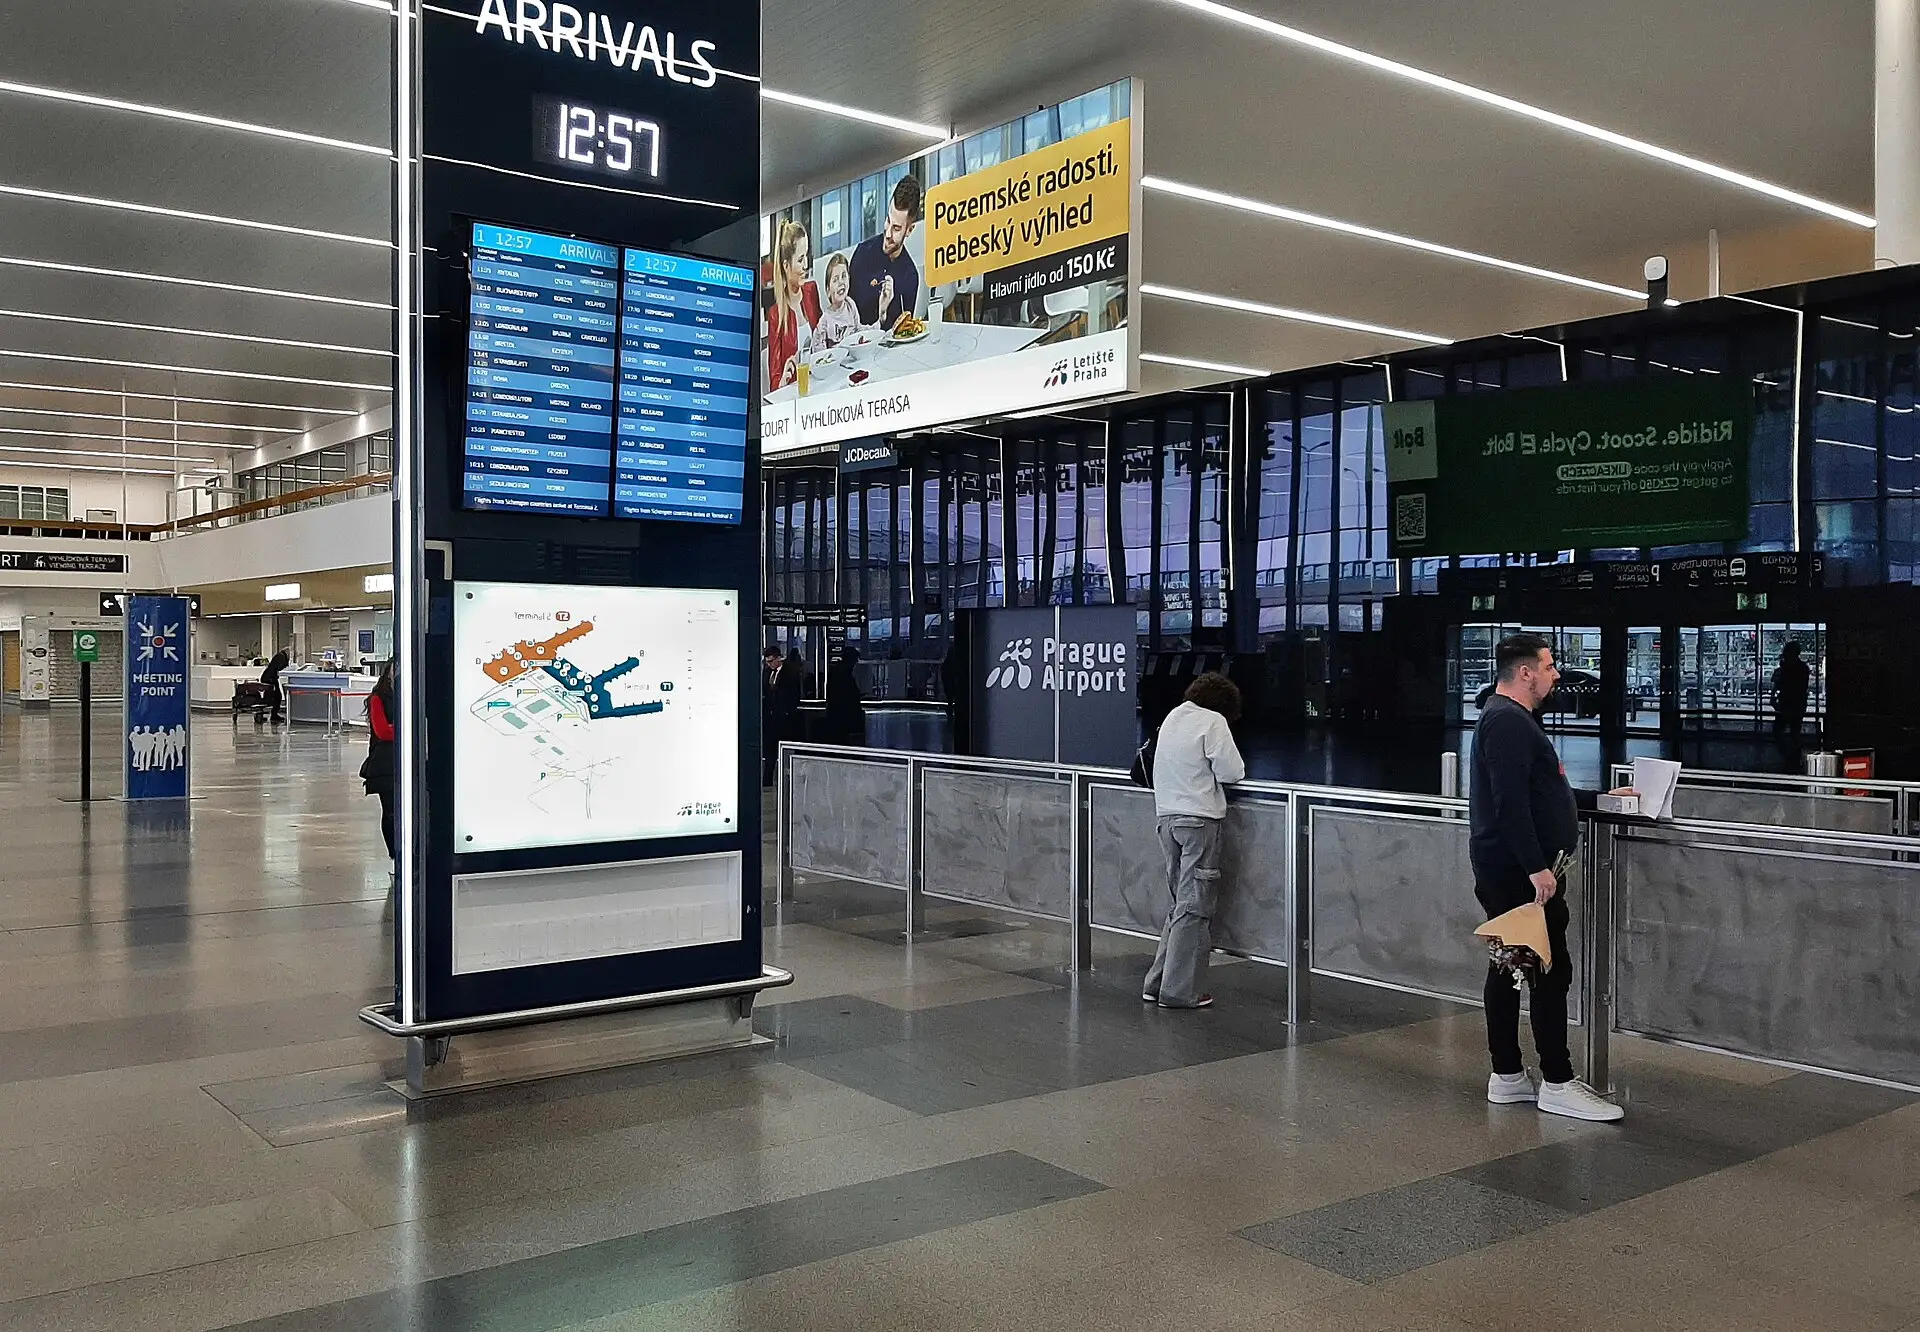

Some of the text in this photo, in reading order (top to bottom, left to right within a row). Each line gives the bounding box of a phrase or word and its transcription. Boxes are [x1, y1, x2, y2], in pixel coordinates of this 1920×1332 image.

[475, 0, 717, 88] ARRIVALS
[558, 103, 660, 178] 12:57
[933, 143, 1119, 230] Pozemské radosti,
[477, 229, 617, 264] 1 12:57 ARRIVALS
[933, 193, 1093, 269] nebeský výhled
[628, 254, 752, 286] 2 12:57 ARRIVALS
[990, 246, 1116, 300] Hlavní jídlo od 150 Kč
[1073, 348, 1115, 368] Letiště
[1073, 367, 1107, 382] Praha
[801, 393, 911, 431] VYHLÍDKOVÁ TERASA
[844, 446, 891, 464] JCDecaux
[1043, 638, 1126, 669] Prague
[133, 673, 182, 683] MEETING
[141, 686, 176, 696] POINT
[1042, 664, 1126, 697] Airport
